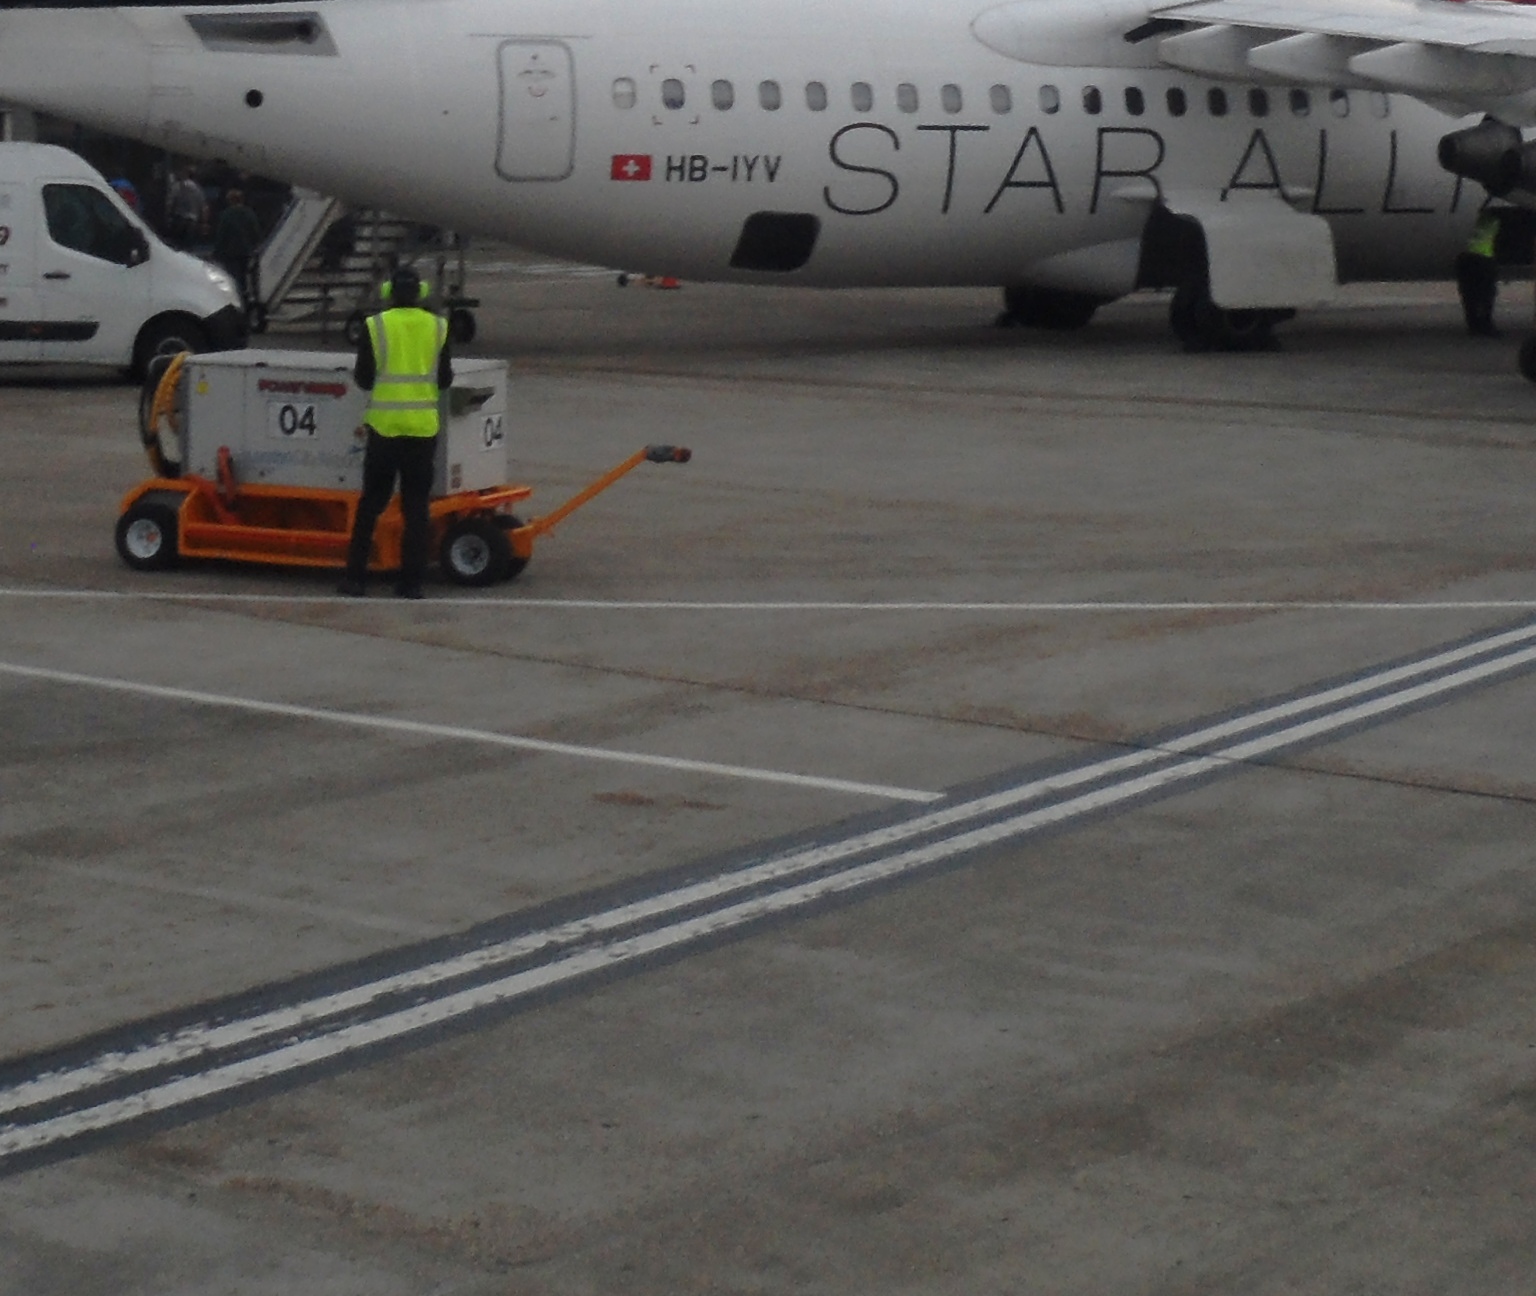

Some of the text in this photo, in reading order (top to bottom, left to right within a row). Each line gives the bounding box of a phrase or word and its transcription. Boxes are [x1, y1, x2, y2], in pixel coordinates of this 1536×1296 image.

[665, 154, 782, 183] HB-IYV
[824, 122, 1164, 215] STAR
[279, 404, 317, 435] 04
[484, 416, 503, 447] 04
